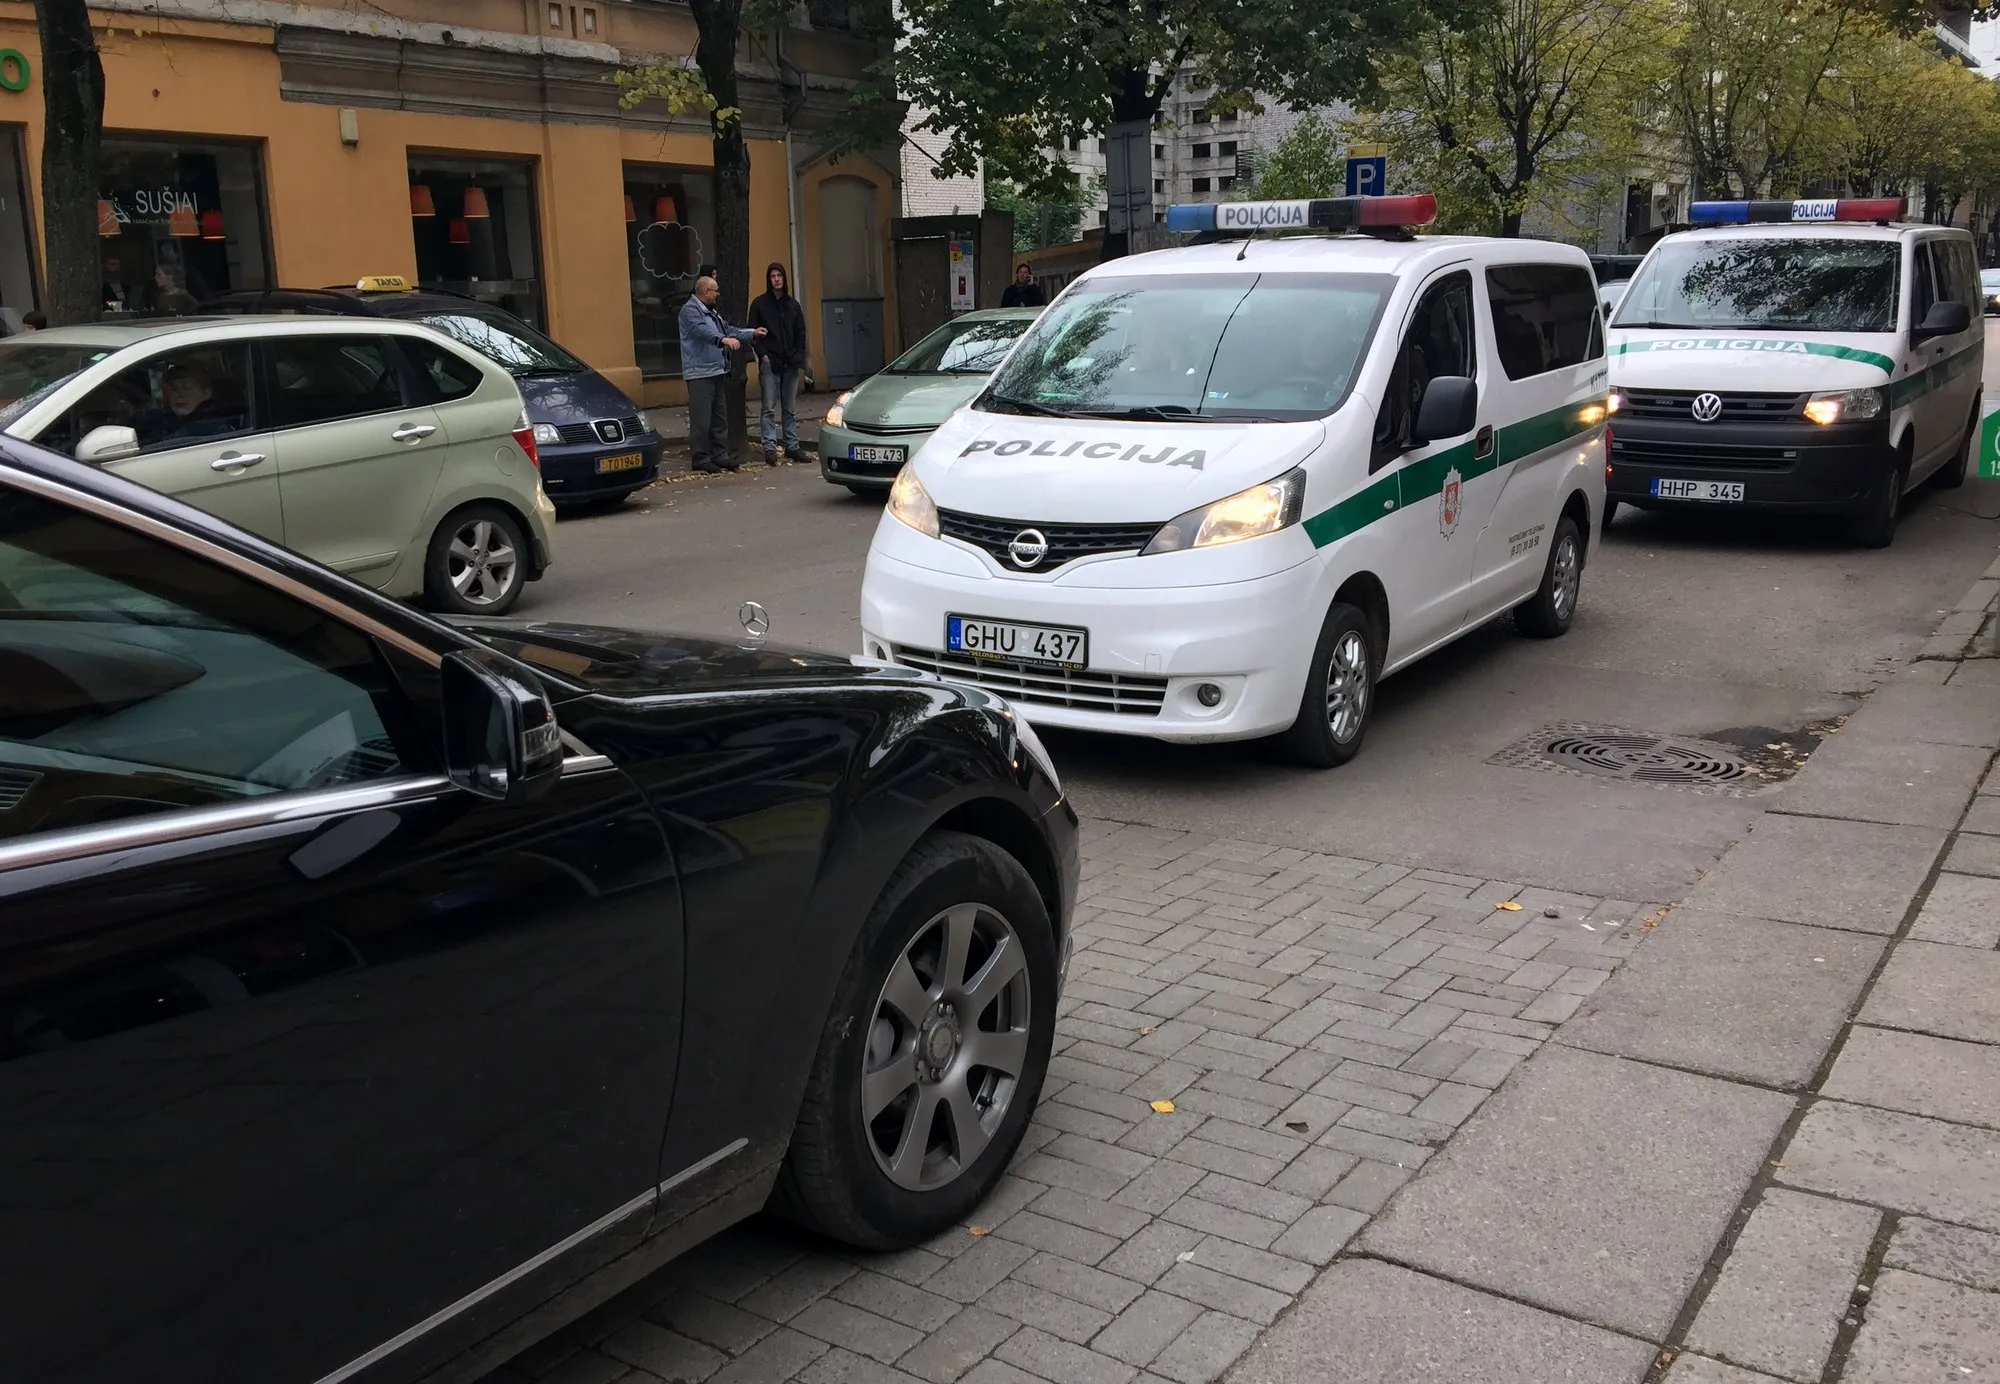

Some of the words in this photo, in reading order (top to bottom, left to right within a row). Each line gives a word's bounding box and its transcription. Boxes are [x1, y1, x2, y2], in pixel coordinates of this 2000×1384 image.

[1356, 163, 1377, 195] P
[135, 185, 198, 214] SUŠIAI
[1225, 206, 1303, 226] POLICIJA
[1792, 203, 1835, 218] POLICIJA
[372, 278, 403, 287] TAKSI
[1650, 339, 1808, 353] POLICIJA
[855, 447, 877, 460] HEB
[883, 449, 903, 461] 473
[958, 439, 1207, 471] POLICIJA
[1660, 480, 1697, 497] HHP
[1709, 483, 1741, 499] 345
[1010, 543, 1043, 553] NISSAN
[950, 636, 961, 645] LT
[964, 624, 1016, 652] GHU
[1033, 631, 1080, 660] 437
